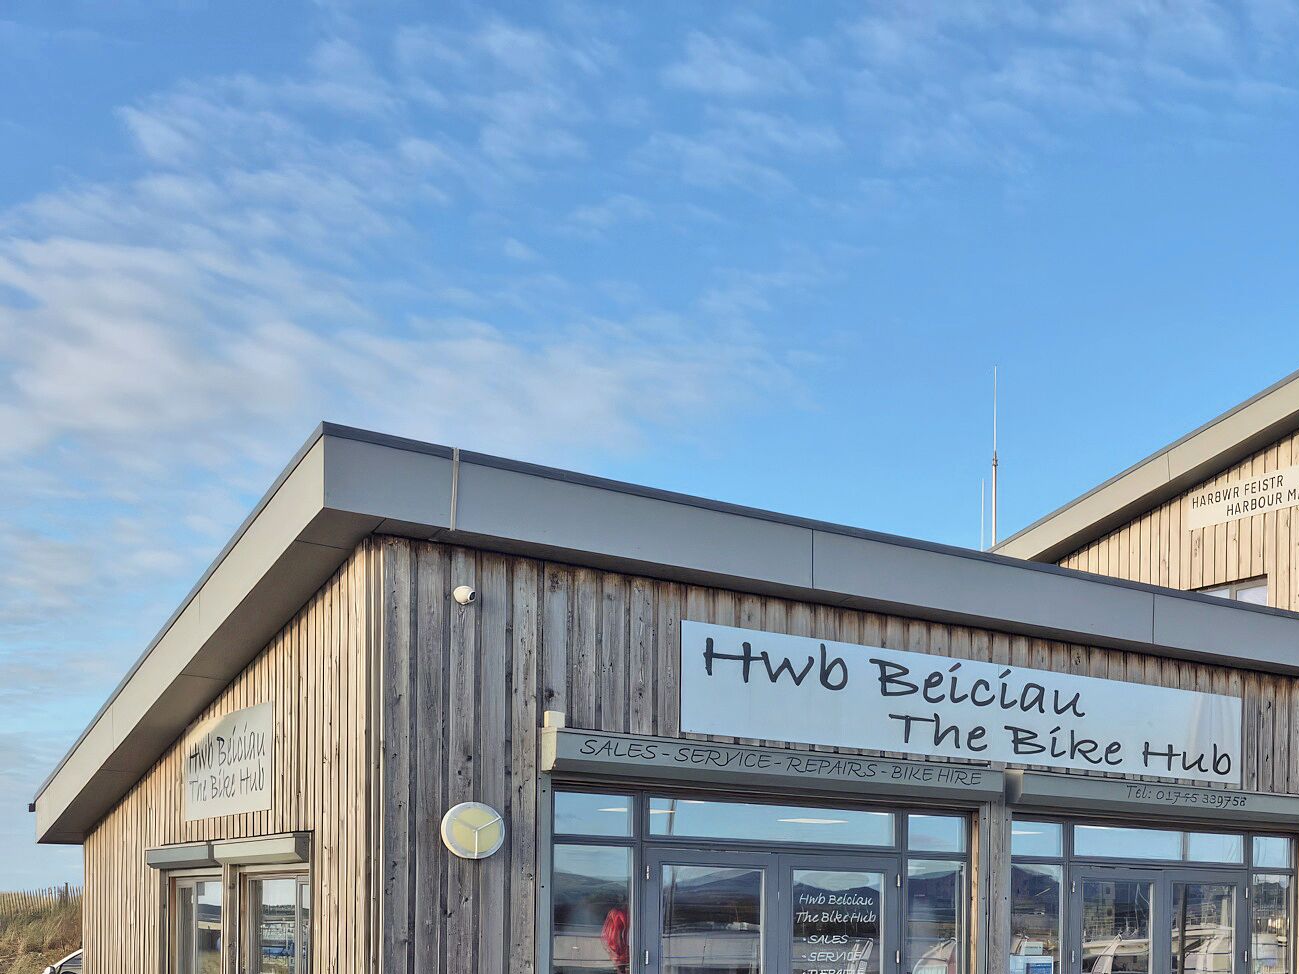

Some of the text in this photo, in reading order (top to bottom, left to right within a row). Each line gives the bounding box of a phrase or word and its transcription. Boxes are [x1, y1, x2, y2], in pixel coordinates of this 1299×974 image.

[1193, 475, 1284, 509] HARBWR FEISTR
[1226, 492, 1283, 517] HARBOUR
[703, 637, 848, 691] Hwb
[888, 712, 1232, 776] The Bike Hub
[579, 739, 657, 760] SALES
[674, 747, 773, 768] SERVICE
[786, 757, 878, 778] REPAIRS
[891, 765, 933, 782] BIKE
[937, 768, 982, 786] HIRE
[240, 759, 265, 796] Hub
[799, 893, 826, 905] Hwb
[795, 910, 820, 923] The
[807, 934, 849, 944] SALES
[807, 951, 862, 962] SERVICE
